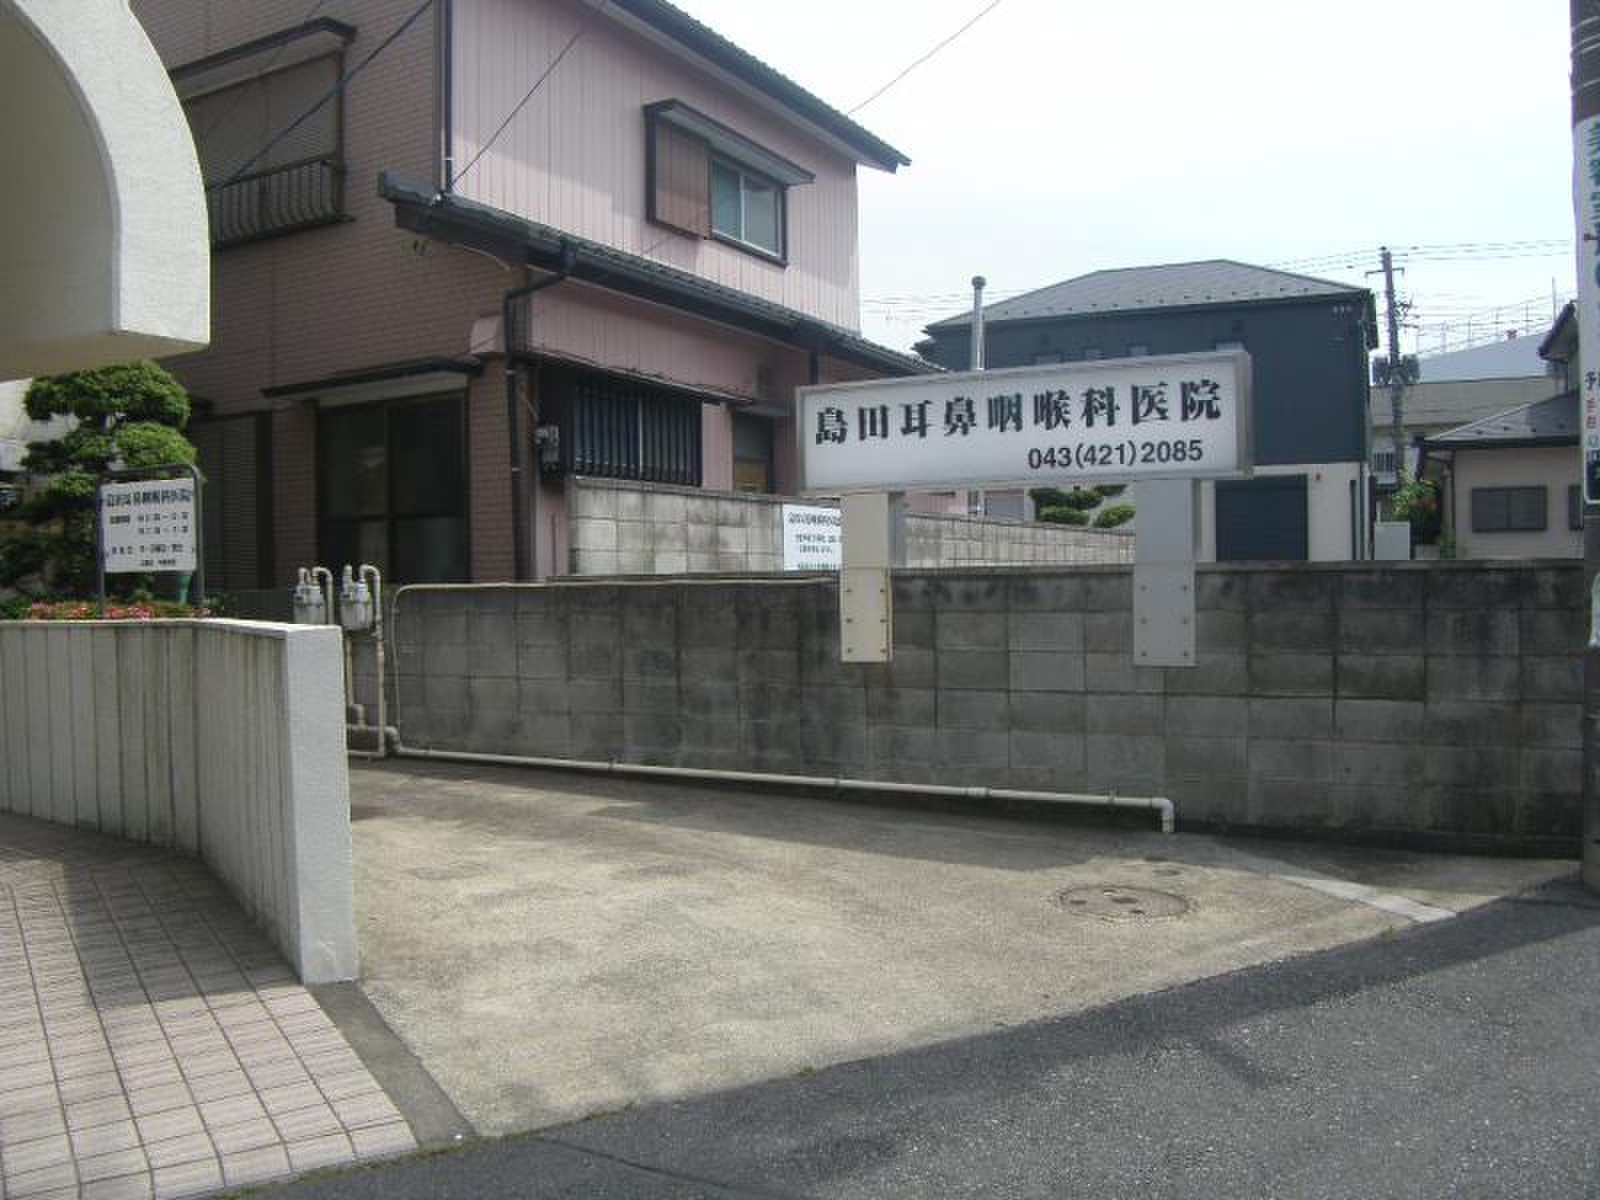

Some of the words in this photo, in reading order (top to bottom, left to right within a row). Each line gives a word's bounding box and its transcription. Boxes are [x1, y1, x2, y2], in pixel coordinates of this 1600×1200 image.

[815, 379, 1222, 445] 島田耳鼻咽喉科医院
[1028, 439, 1203, 470] 043(421)2085
